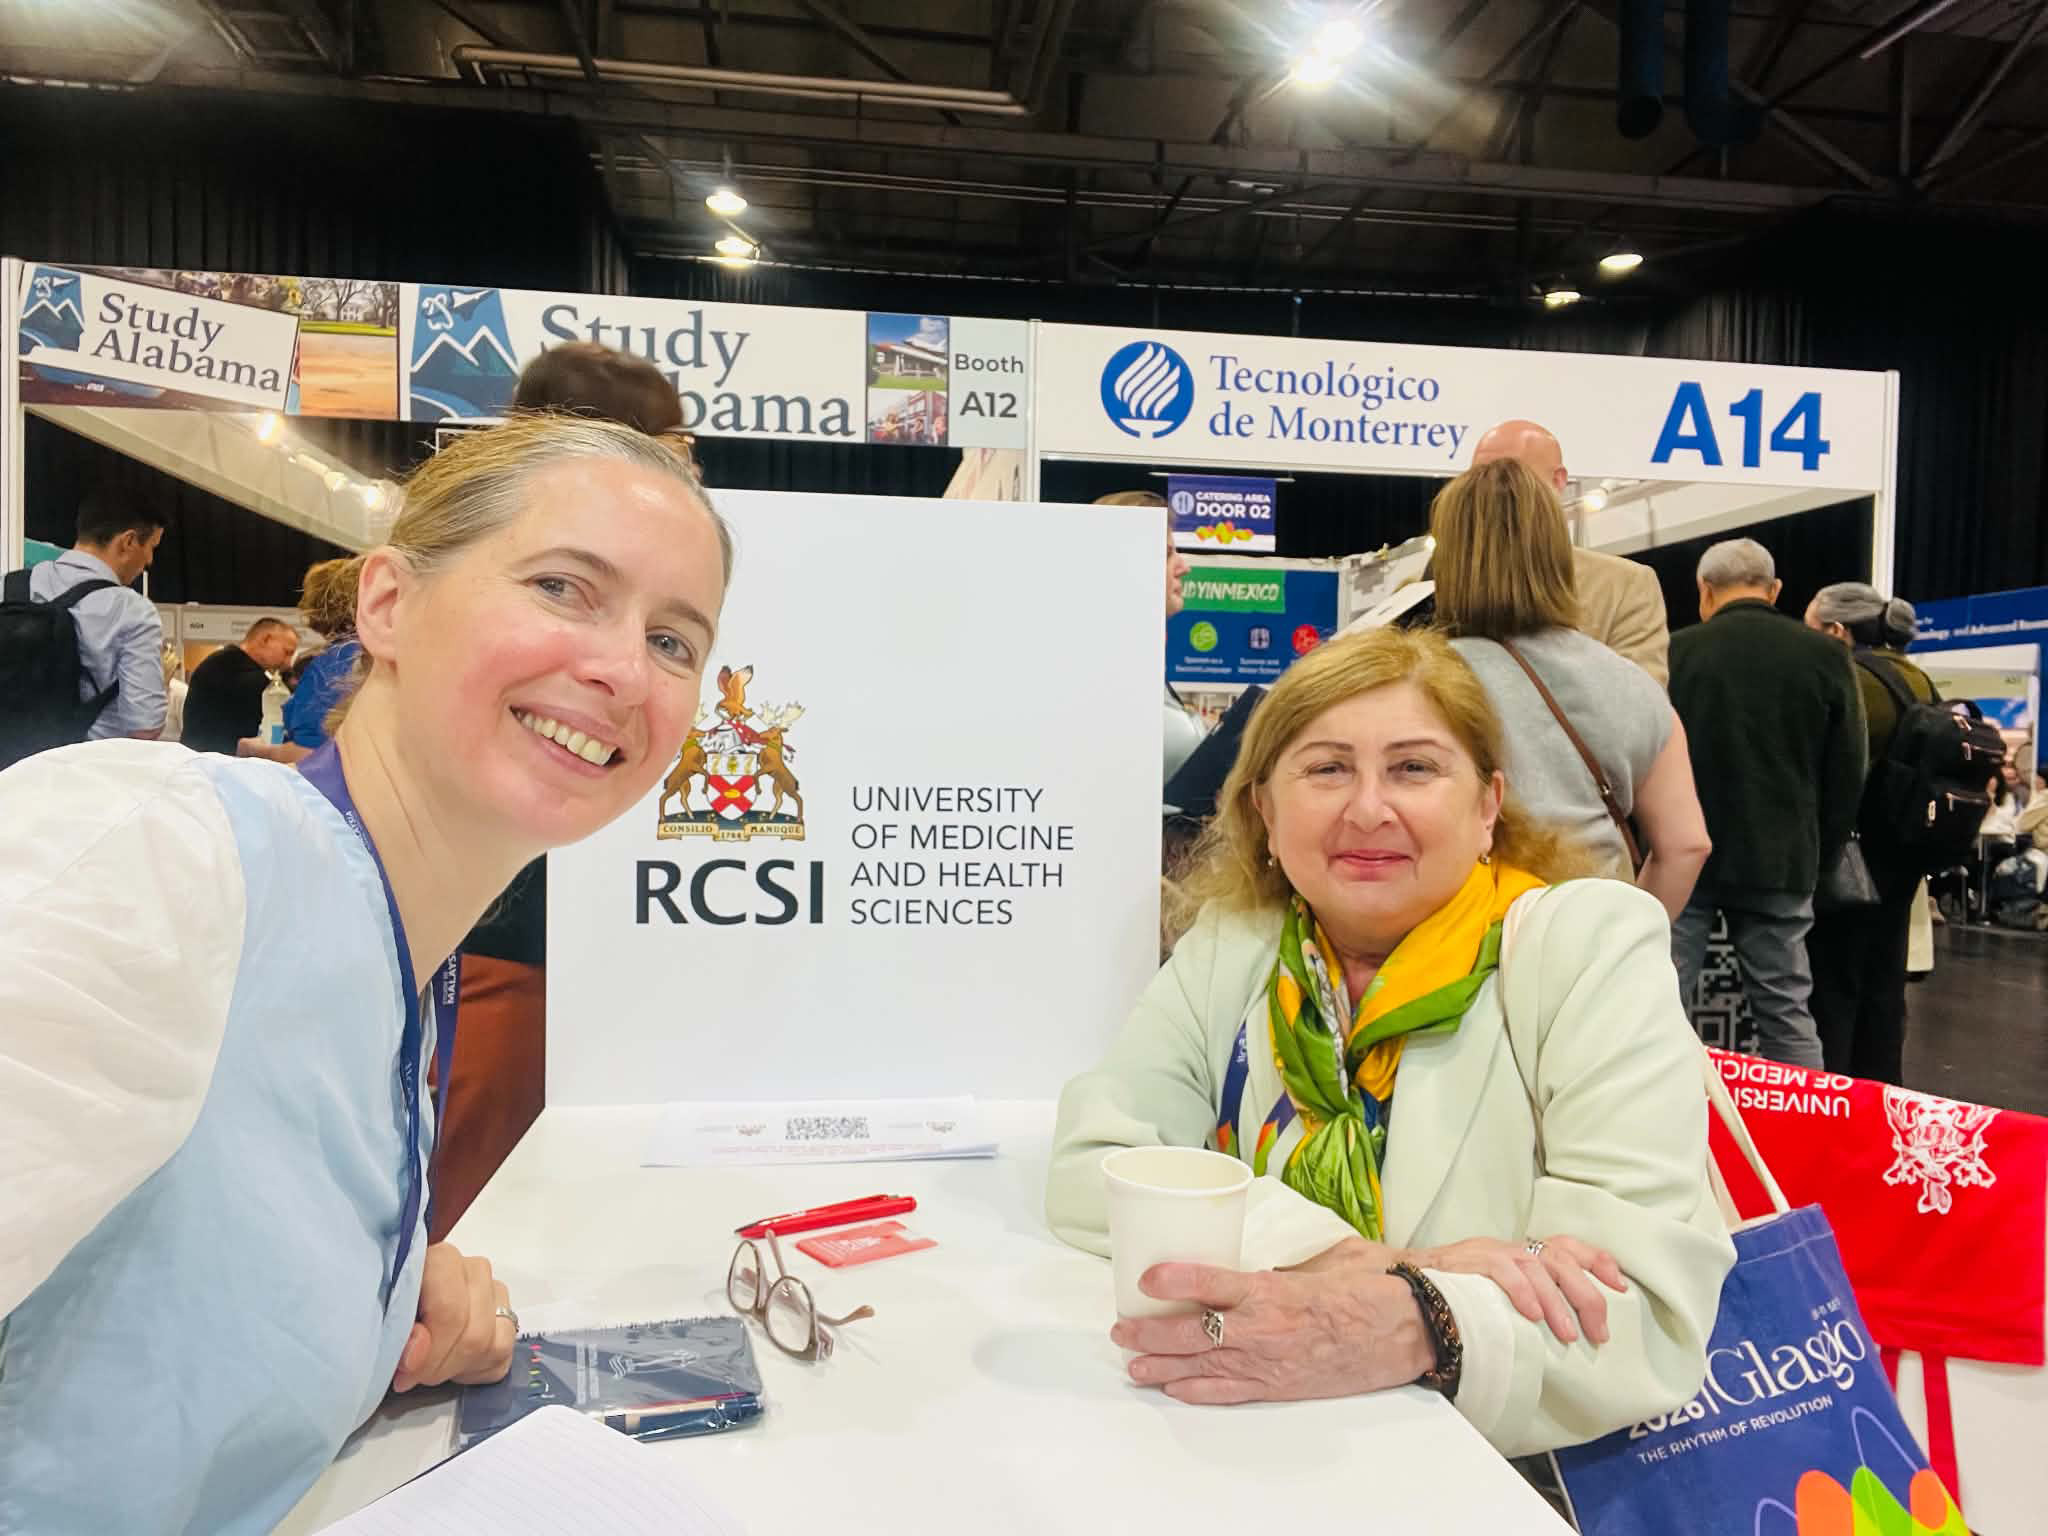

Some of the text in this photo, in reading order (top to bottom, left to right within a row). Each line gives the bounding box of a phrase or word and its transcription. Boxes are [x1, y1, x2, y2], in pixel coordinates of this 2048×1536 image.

[98, 292, 225, 353] Study
[90, 327, 283, 393] Alabama
[954, 353, 1024, 374] Booth
[1209, 354, 1440, 411] Tecnológico
[664, 370, 857, 437] bama
[960, 391, 1018, 419] A12
[1209, 400, 1469, 460] de Monterrey
[1650, 382, 1830, 471] A14
[1195, 491, 1271, 504] CATERING AREA
[1196, 503, 1272, 519] DOOR 02
[852, 786, 1044, 813] UNIVERSITY
[663, 825, 713, 833] CONSILIO
[750, 825, 801, 834] MANUQUE
[851, 824, 1074, 851] OF MEDICINE
[850, 862, 1064, 888] AND HEALTH
[635, 859, 824, 926] RCSI
[850, 900, 1013, 925] SCIENCES
[447, 952, 457, 1004] MALAYS
[1717, 1057, 1854, 1091] OF MEDICI
[1734, 1086, 1851, 1119] UNIVERSI
[1705, 1320, 1866, 1406] Glasgo
[1638, 1395, 1833, 1465] THE RHYTHM OF REVOLUTION
